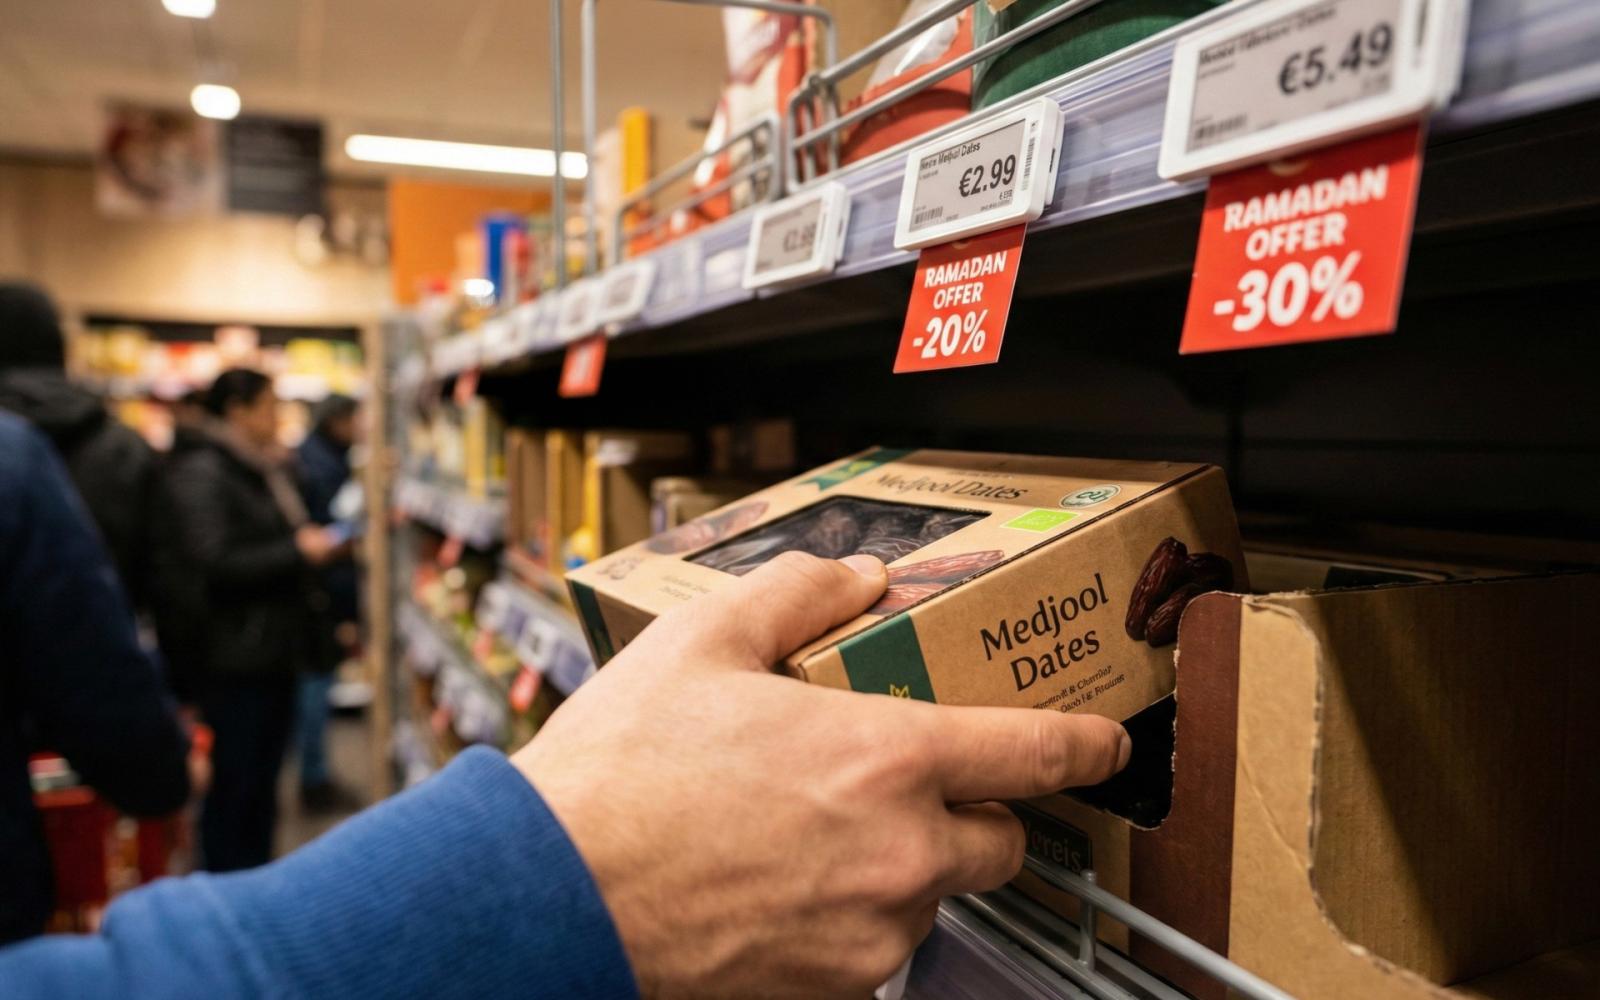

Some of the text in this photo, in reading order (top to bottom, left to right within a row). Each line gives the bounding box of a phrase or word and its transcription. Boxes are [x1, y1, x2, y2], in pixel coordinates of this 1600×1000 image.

[1278, 21, 1394, 95] €5.49
[958, 154, 1016, 198] €2.99
[1223, 164, 1389, 233] RAMADAN
[1245, 212, 1347, 261] OFFER
[924, 250, 1008, 288] RAMADAN
[1213, 251, 1364, 332] -30%
[933, 282, 984, 310] OFFER
[912, 309, 988, 359] -20%
[873, 473, 964, 495] Medjool
[955, 480, 1028, 500] Dates
[979, 572, 1109, 661] Medjool
[1010, 629, 1101, 692] Dates
